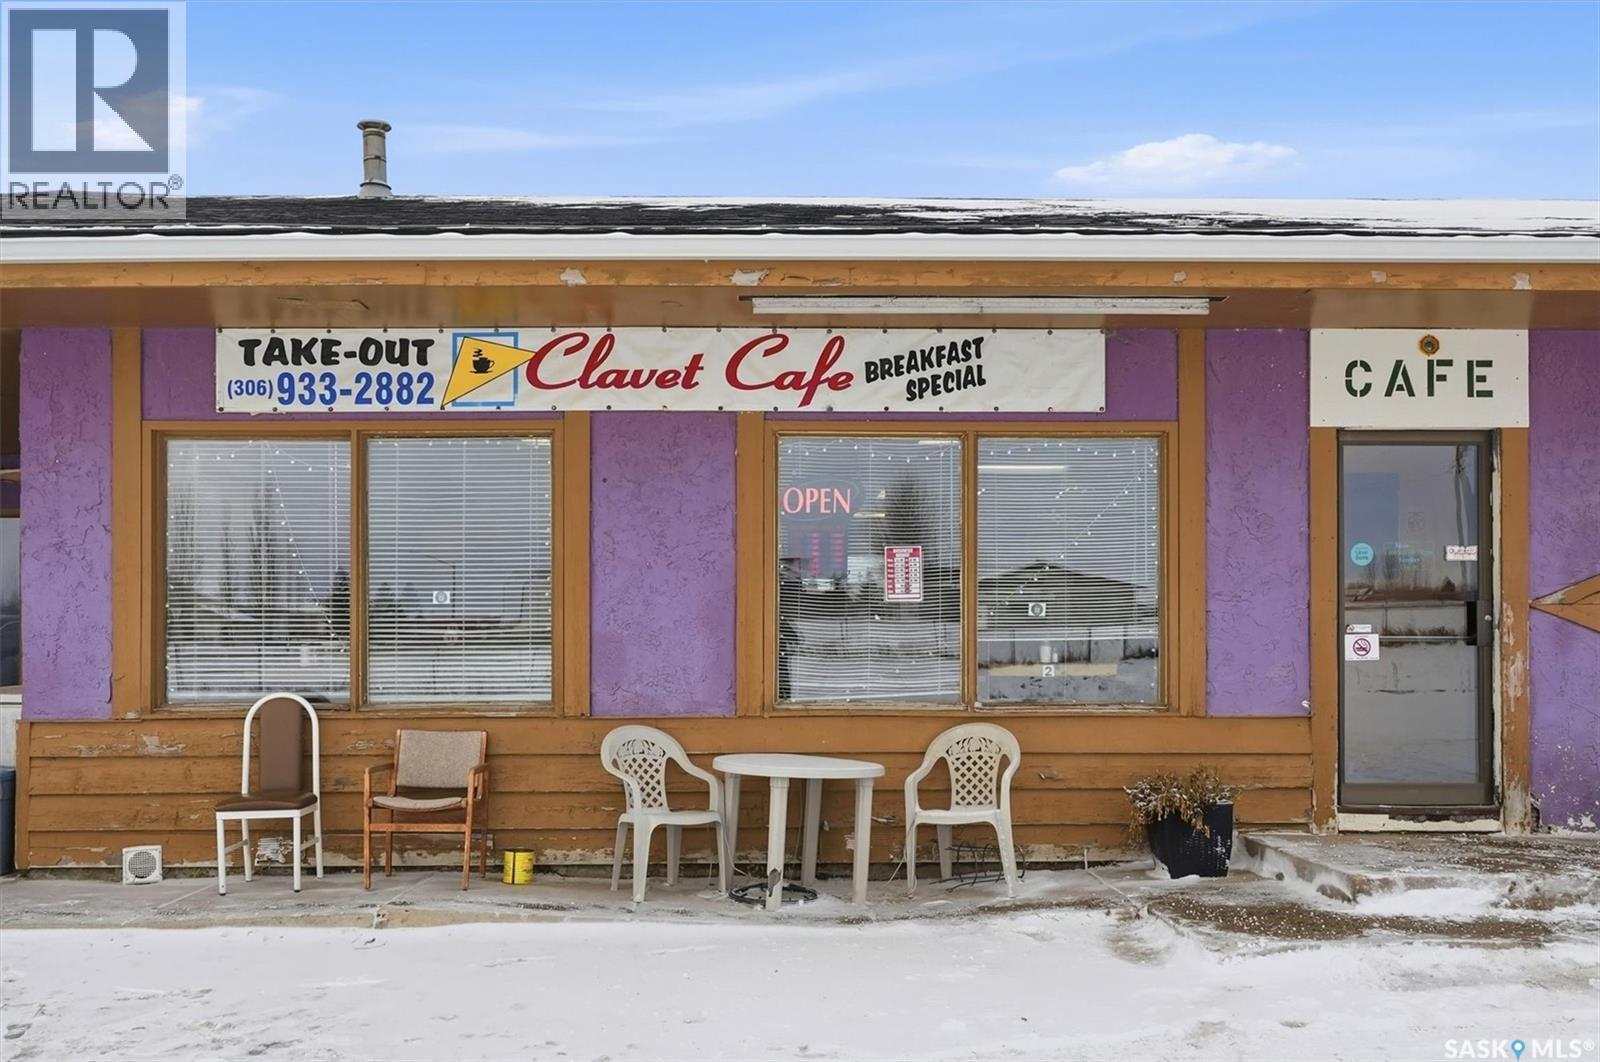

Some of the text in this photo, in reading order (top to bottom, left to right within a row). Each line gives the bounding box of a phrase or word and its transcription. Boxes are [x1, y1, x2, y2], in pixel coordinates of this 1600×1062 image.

[237, 337, 435, 367] TAKE-OUT
[525, 332, 854, 408] Clavet Cafe
[864, 336, 985, 384] BREAKFAST
[226, 372, 435, 406] (306) 933-2882
[906, 365, 987, 402] SPECIAL
[1344, 359, 1494, 398] CAFE
[782, 487, 851, 514] OPEN
